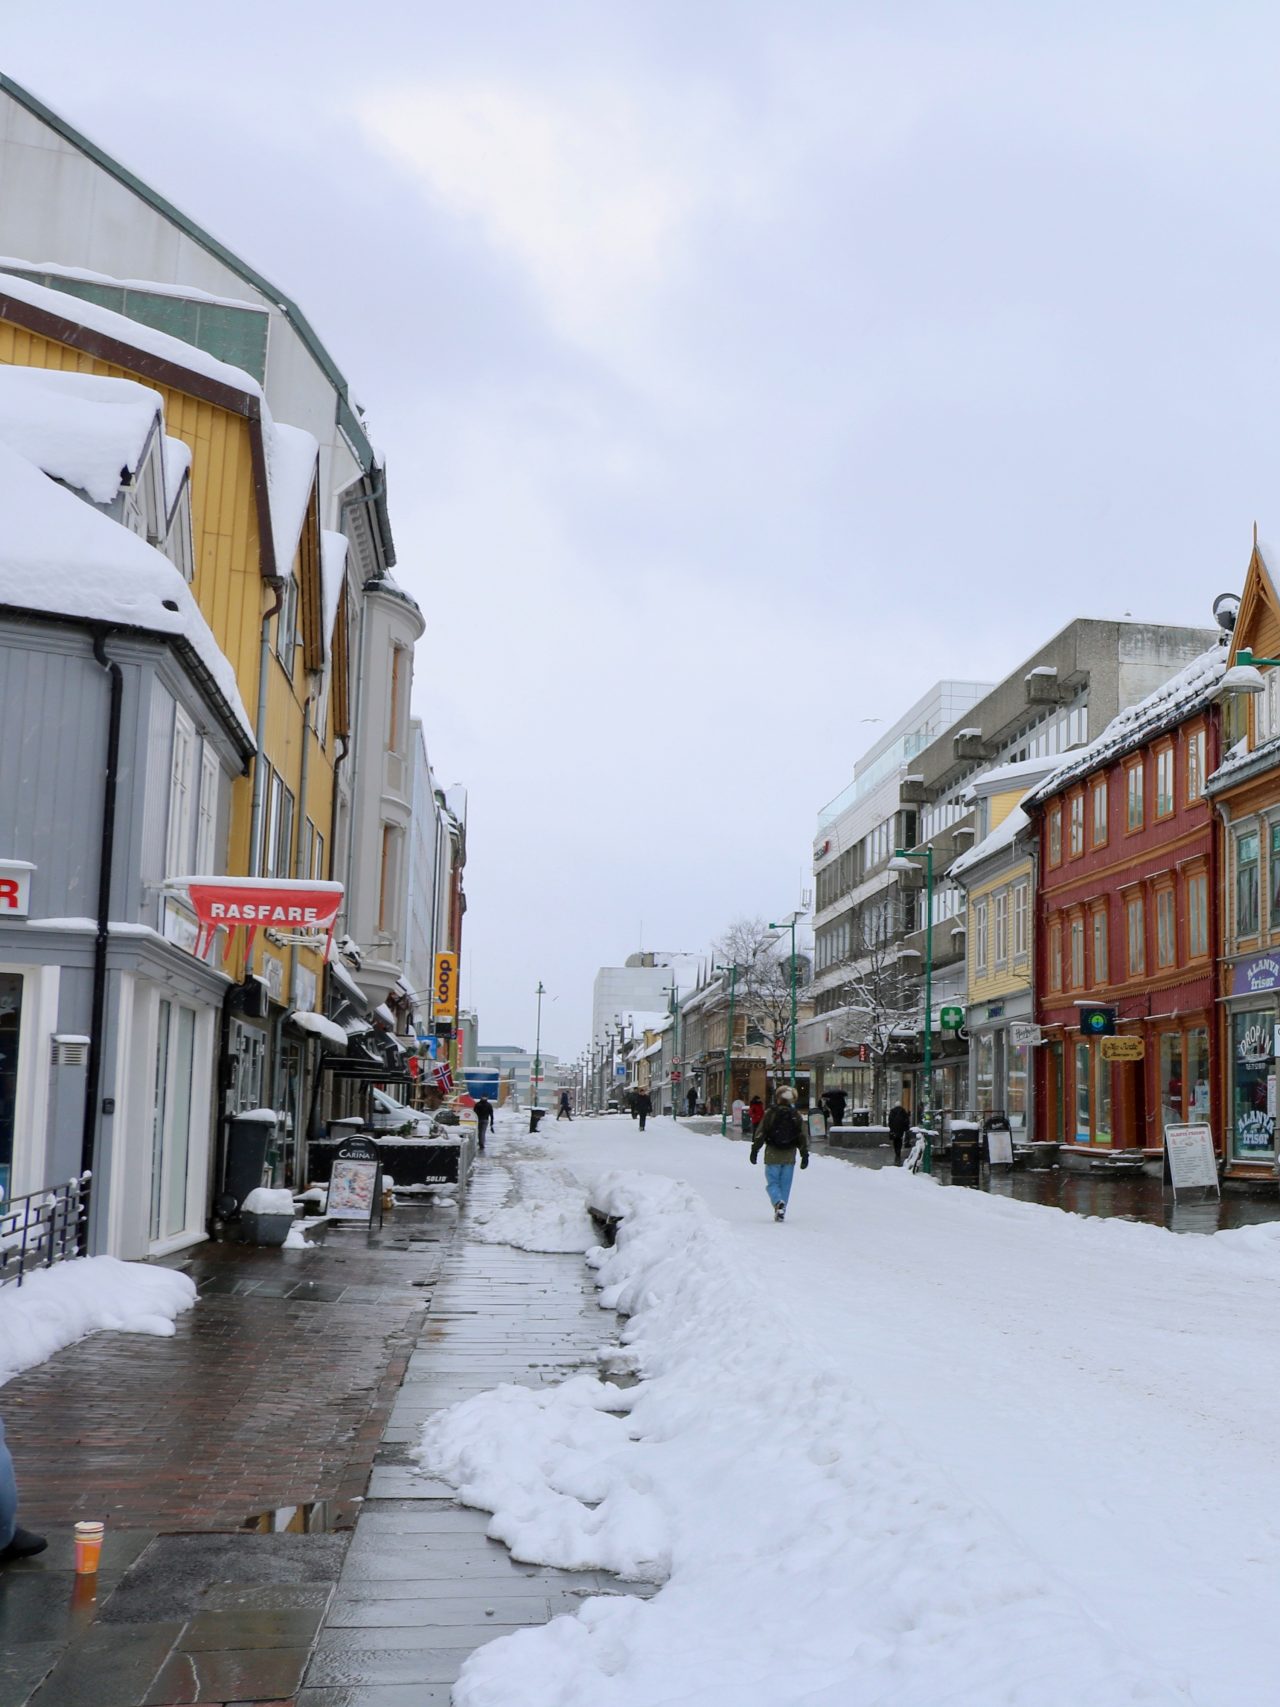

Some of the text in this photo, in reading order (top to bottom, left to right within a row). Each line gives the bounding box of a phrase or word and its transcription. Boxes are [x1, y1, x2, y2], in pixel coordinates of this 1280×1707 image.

[210, 903, 318, 922] RASFARE
[1247, 959, 1280, 981] ALANYA
[438, 959, 452, 1004] coop
[1250, 976, 1275, 990] frisør
[1240, 1025, 1272, 1056] DROP IN
[1238, 1110, 1275, 1135] ALANYA
[1243, 1130, 1269, 1145] frisør
